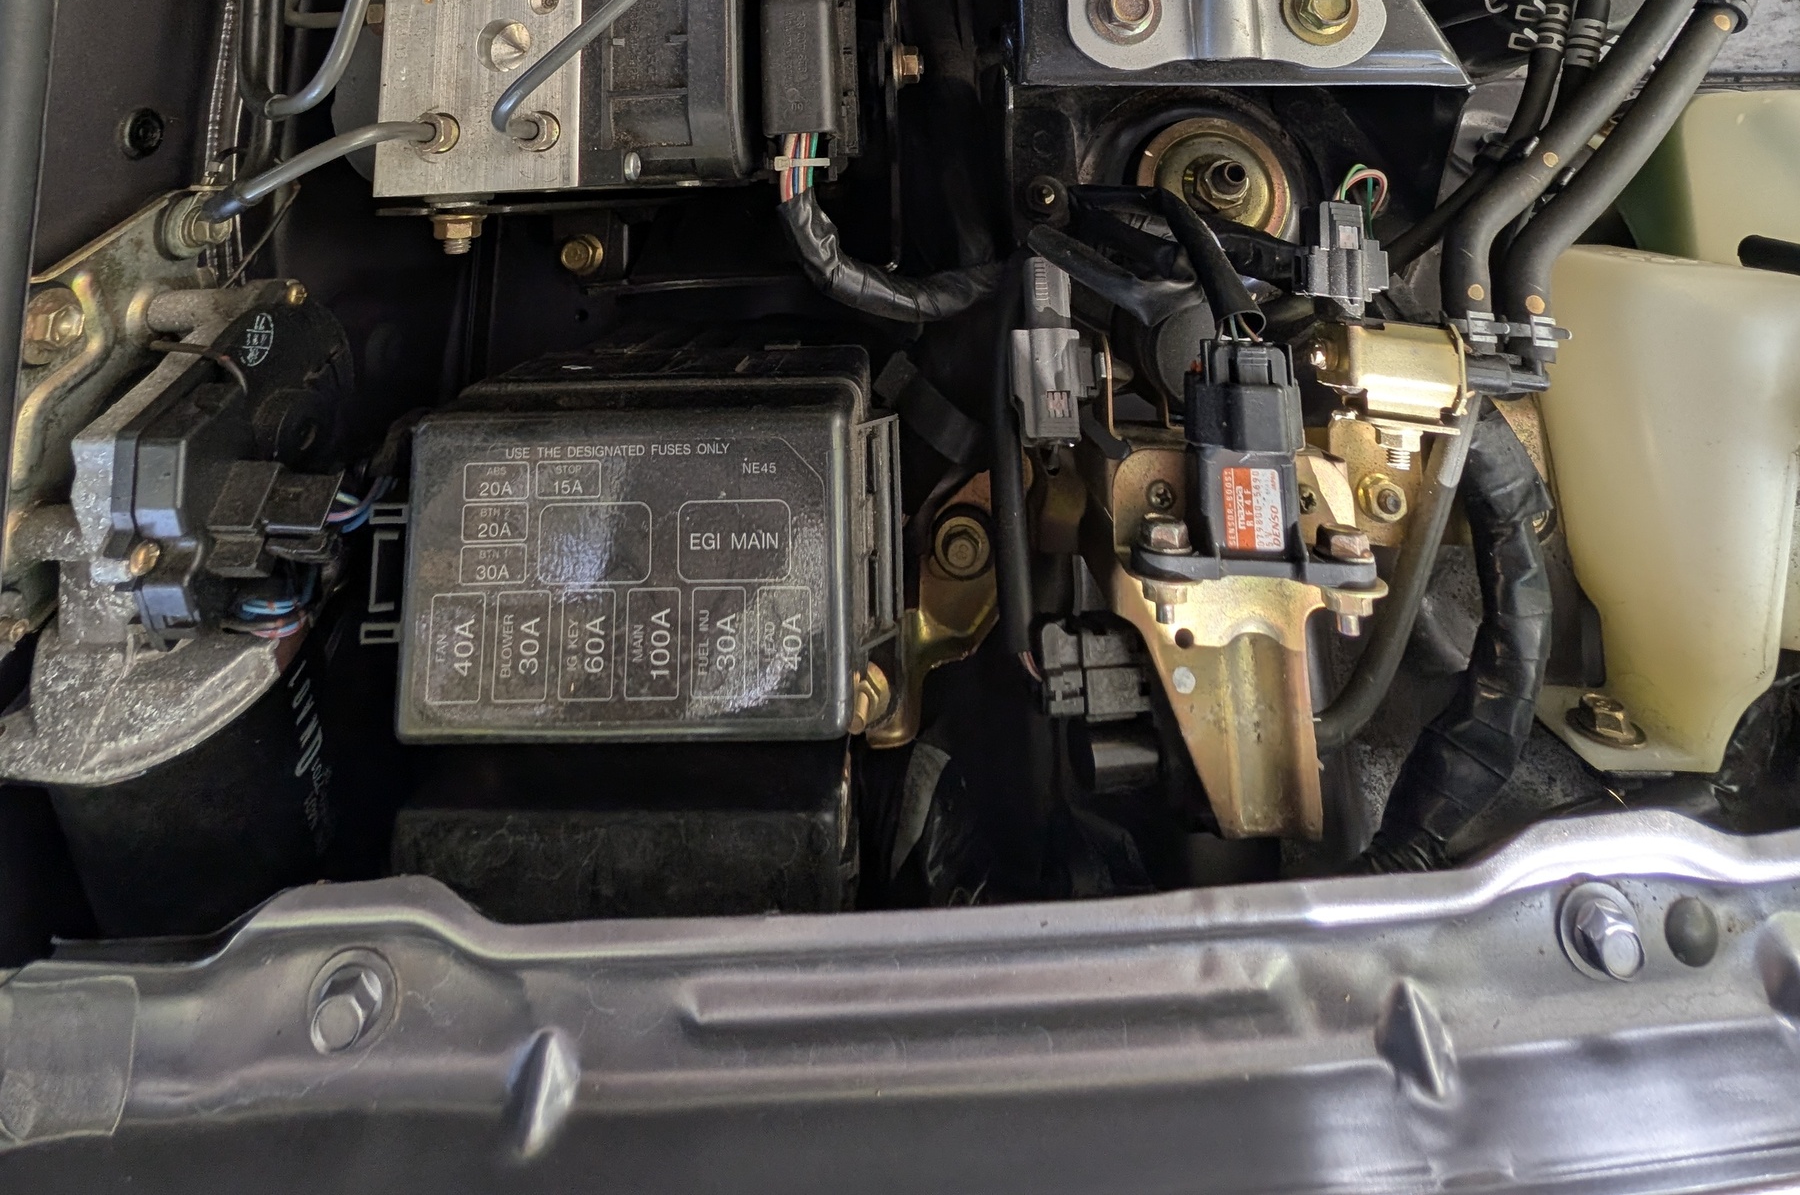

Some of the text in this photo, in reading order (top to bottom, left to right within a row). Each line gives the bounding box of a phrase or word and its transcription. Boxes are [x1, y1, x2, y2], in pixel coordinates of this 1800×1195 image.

[486, 465, 507, 476] ABS
[505, 442, 730, 459] USE THE DESIGNATED FUSES ONLY
[555, 464, 582, 475] STOP
[742, 462, 777, 474] NE45
[479, 480, 513, 497] 20A
[553, 479, 583, 495] 15A
[477, 522, 512, 539] 20A
[690, 532, 779, 550] EGI MAIN
[1269, 505, 1281, 547] DENSO
[475, 564, 510, 581] 30A
[435, 633, 448, 663] FAN
[453, 618, 475, 677] 40A
[499, 614, 515, 679] BLOWER
[518, 616, 541, 675] 30A
[566, 618, 579, 671] IG KEY
[584, 615, 607, 674] 60A
[632, 624, 645, 664] MAIN
[650, 607, 671, 680] 100A
[697, 609, 710, 675] FUEL INJ
[716, 613, 736, 671] 30A
[781, 613, 802, 672] 40A
